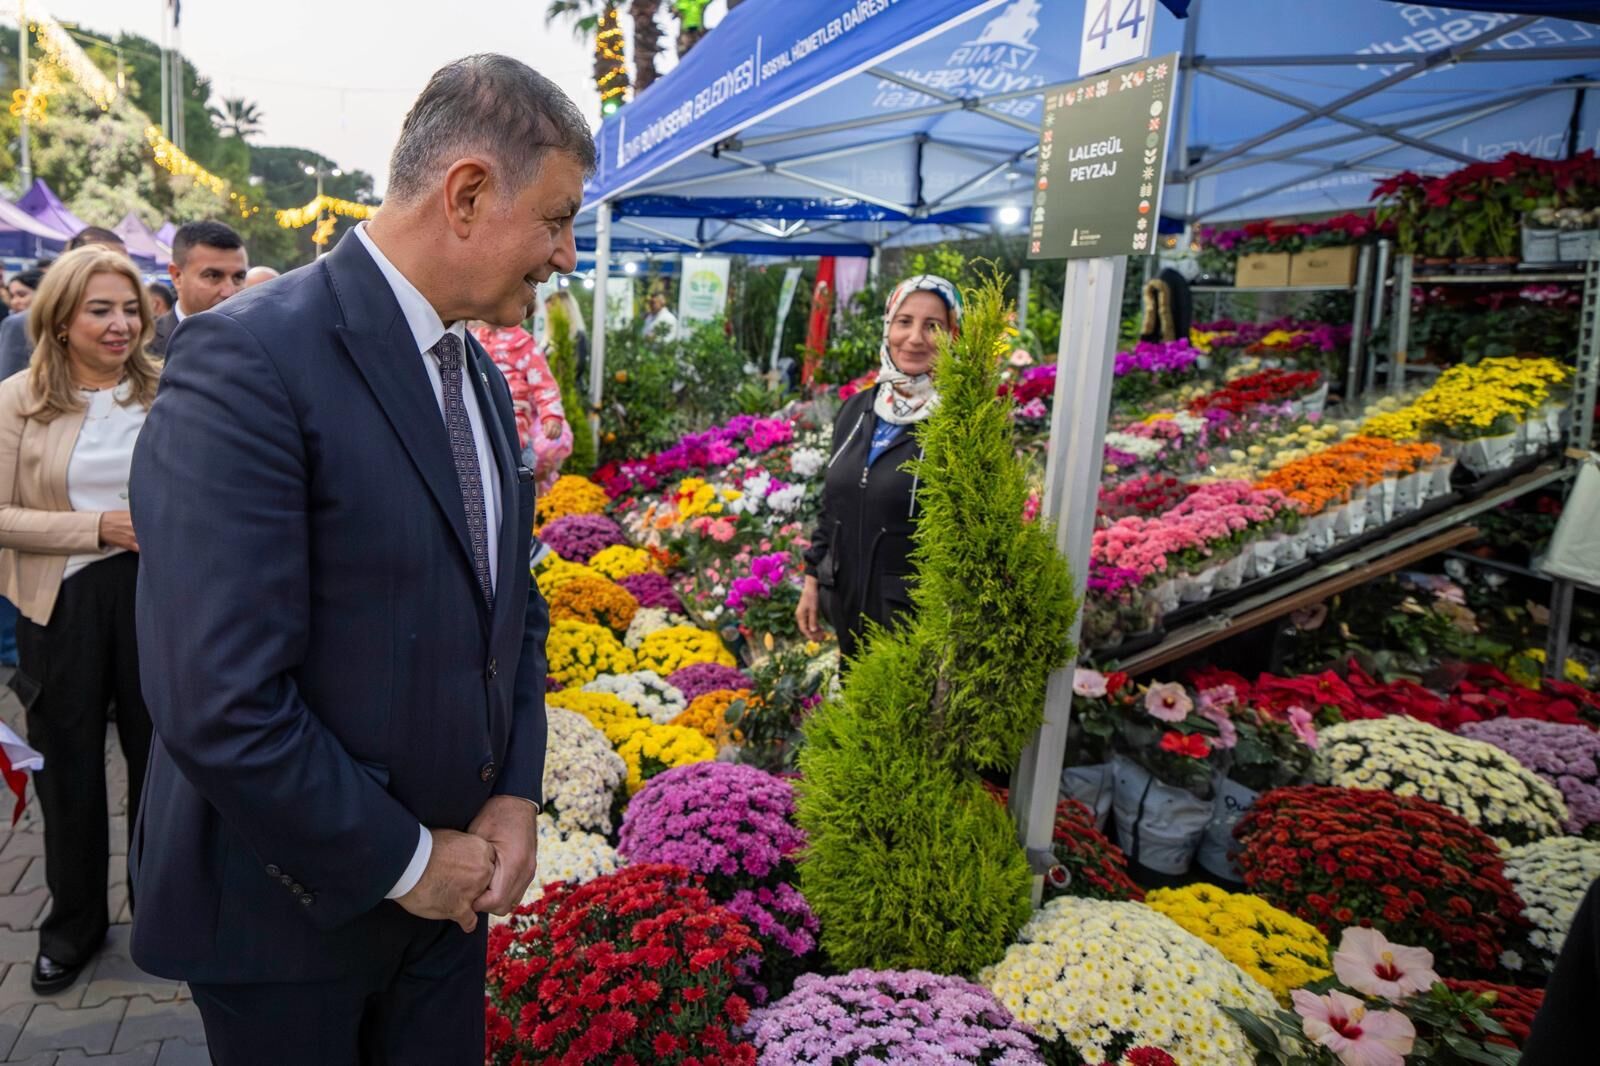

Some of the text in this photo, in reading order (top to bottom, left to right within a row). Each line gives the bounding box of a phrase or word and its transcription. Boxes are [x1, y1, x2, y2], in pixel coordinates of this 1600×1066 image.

[1087, 0, 1146, 50] 44
[1068, 136, 1124, 162] LALEGÜL
[1070, 161, 1117, 182] PEYZAJ
